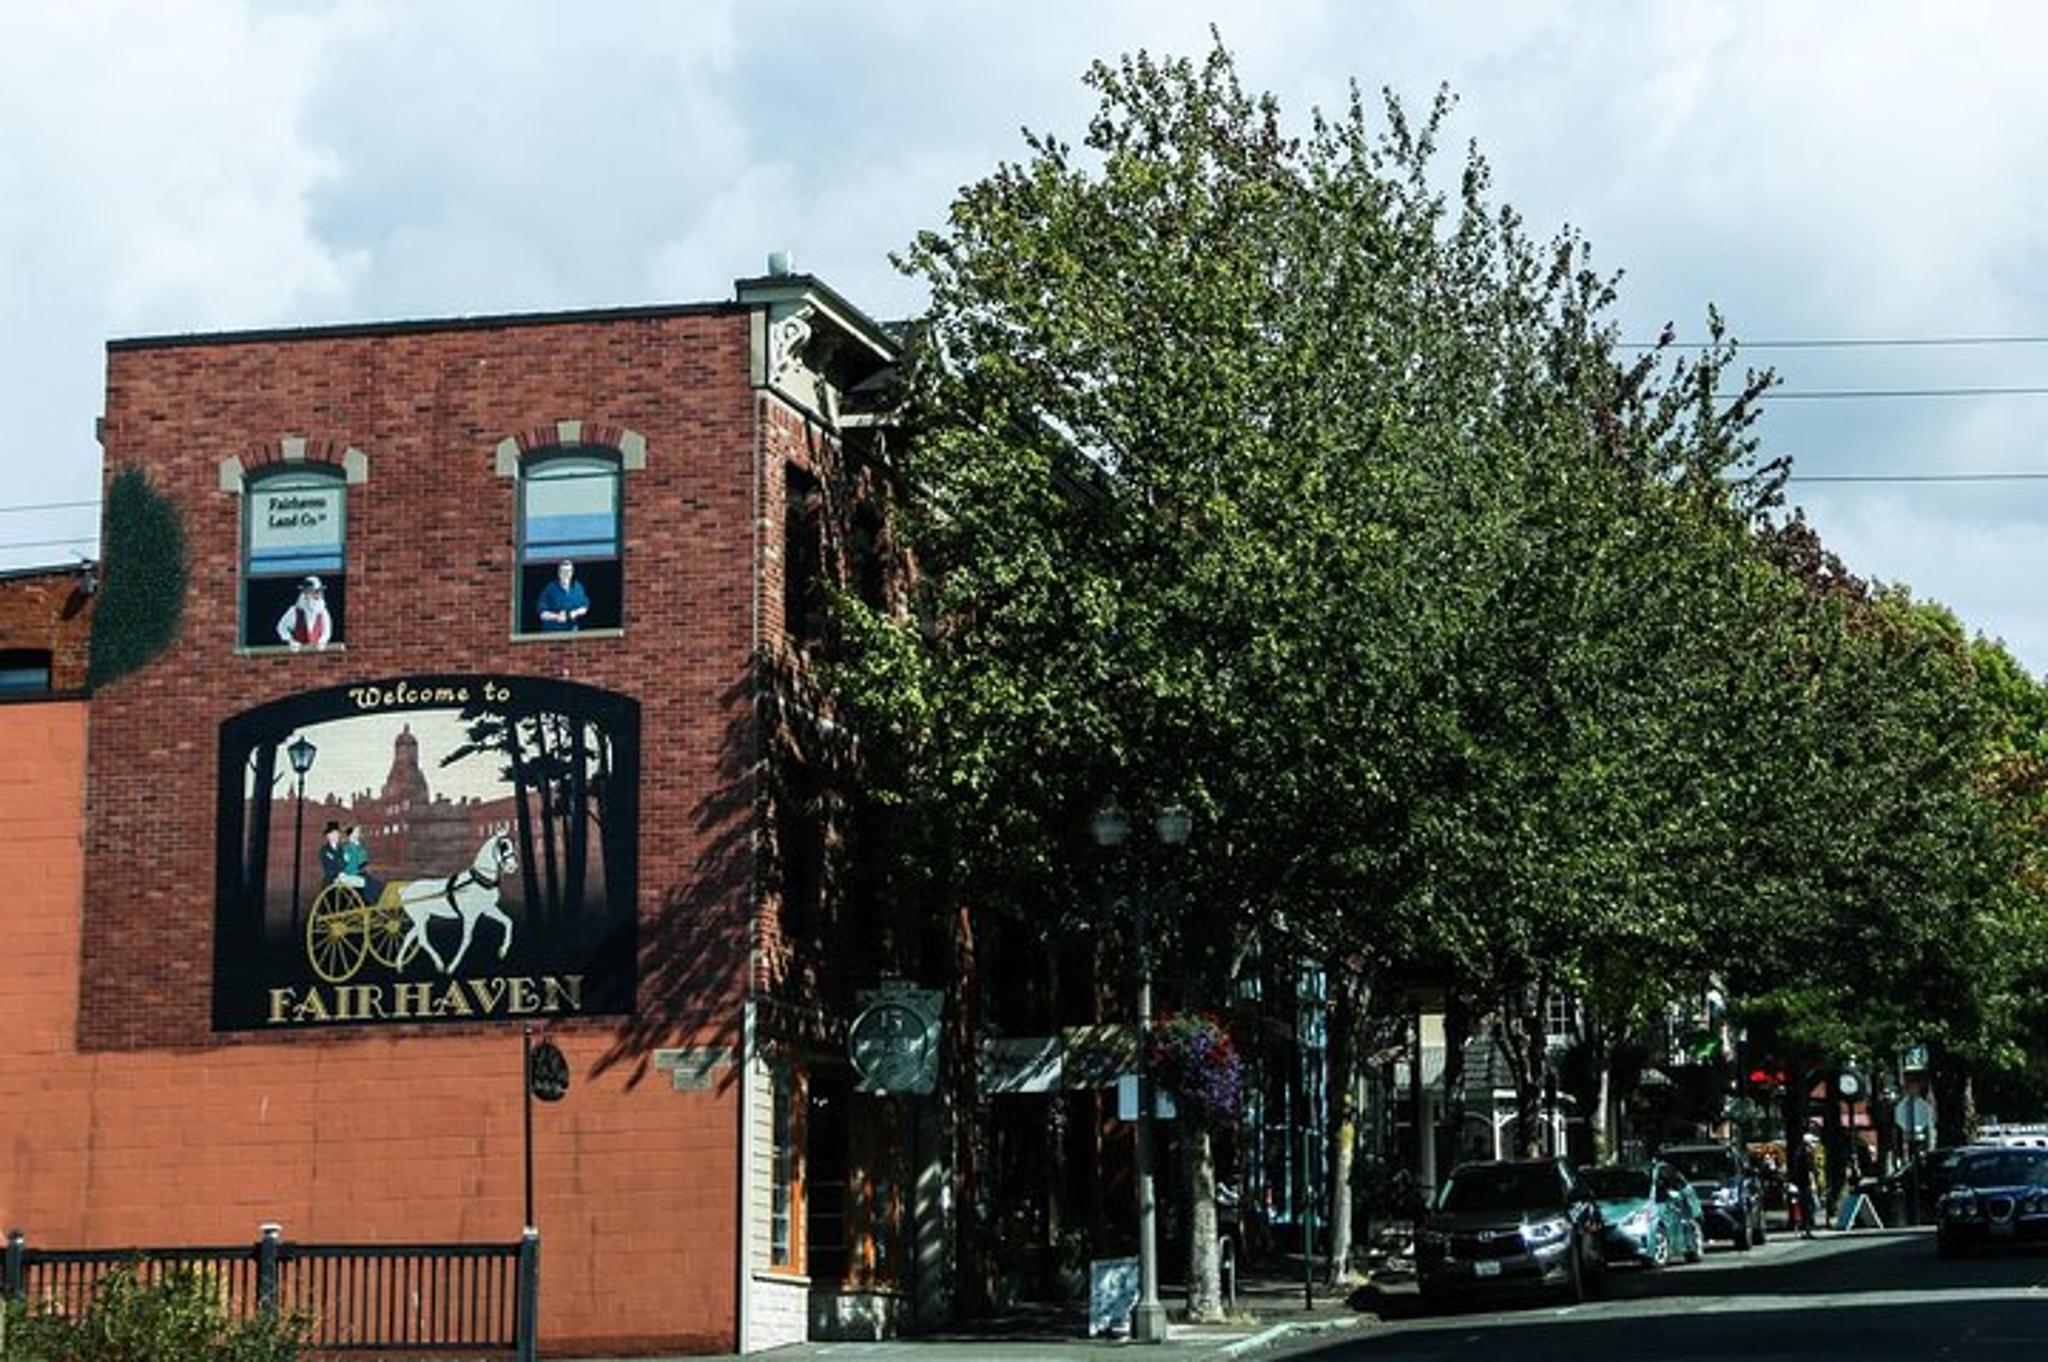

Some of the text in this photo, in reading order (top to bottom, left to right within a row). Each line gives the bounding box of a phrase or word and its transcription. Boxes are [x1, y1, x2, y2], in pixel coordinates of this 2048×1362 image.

[269, 514, 297, 528] Land
[348, 681, 511, 709] Welcome to
[268, 975, 585, 1023] FAIRHAVEN
